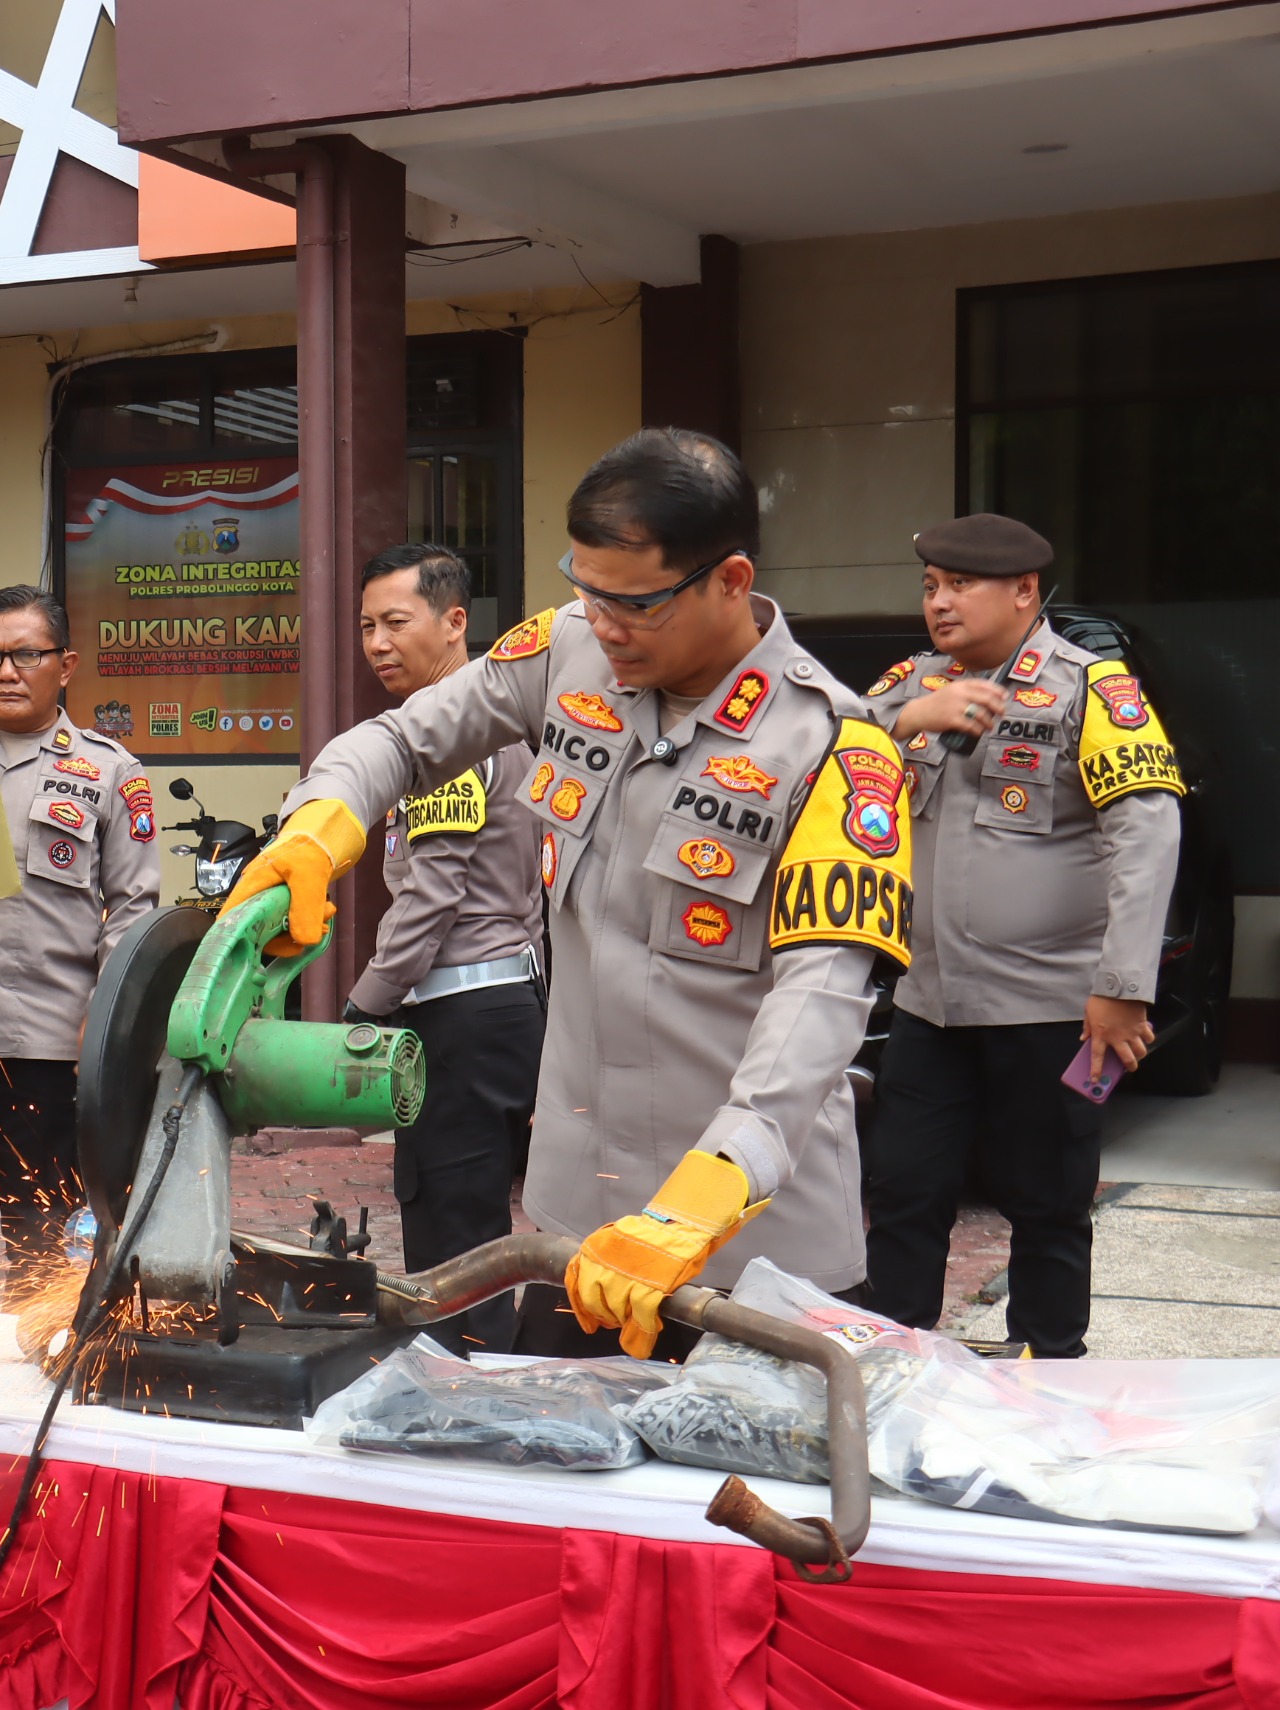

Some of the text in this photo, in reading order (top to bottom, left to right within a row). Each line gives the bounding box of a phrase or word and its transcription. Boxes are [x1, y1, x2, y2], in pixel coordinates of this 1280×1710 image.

[162, 466, 261, 488] PRESISI
[116, 566, 176, 583] ZONA
[130, 582, 294, 596] POLRES PROBOLINGGO KOTA
[99, 615, 301, 649] DUKUNG KAM
[99, 648, 300, 663] MENUJU WILAYAH BEBAS KORUPSI (WBK)
[99, 664, 142, 675] WILAYAH
[144, 664, 194, 674] BIROKRASI
[196, 663, 230, 673] BERSIH
[232, 661, 282, 672] MELAYANI
[151, 704, 179, 714] ZONA
[192, 712, 208, 721] JOIN
[151, 723, 179, 732] POLRES
[997, 720, 1055, 742] POLRI
[543, 721, 610, 772] RICO
[847, 755, 898, 779] POLRES
[1083, 743, 1177, 785] KA SATGA
[44, 780, 101, 805] POLRI
[857, 779, 875, 787] JAWA
[672, 785, 774, 843] POLRI
[701, 842, 716, 854] SAR
[773, 863, 817, 935] KA
